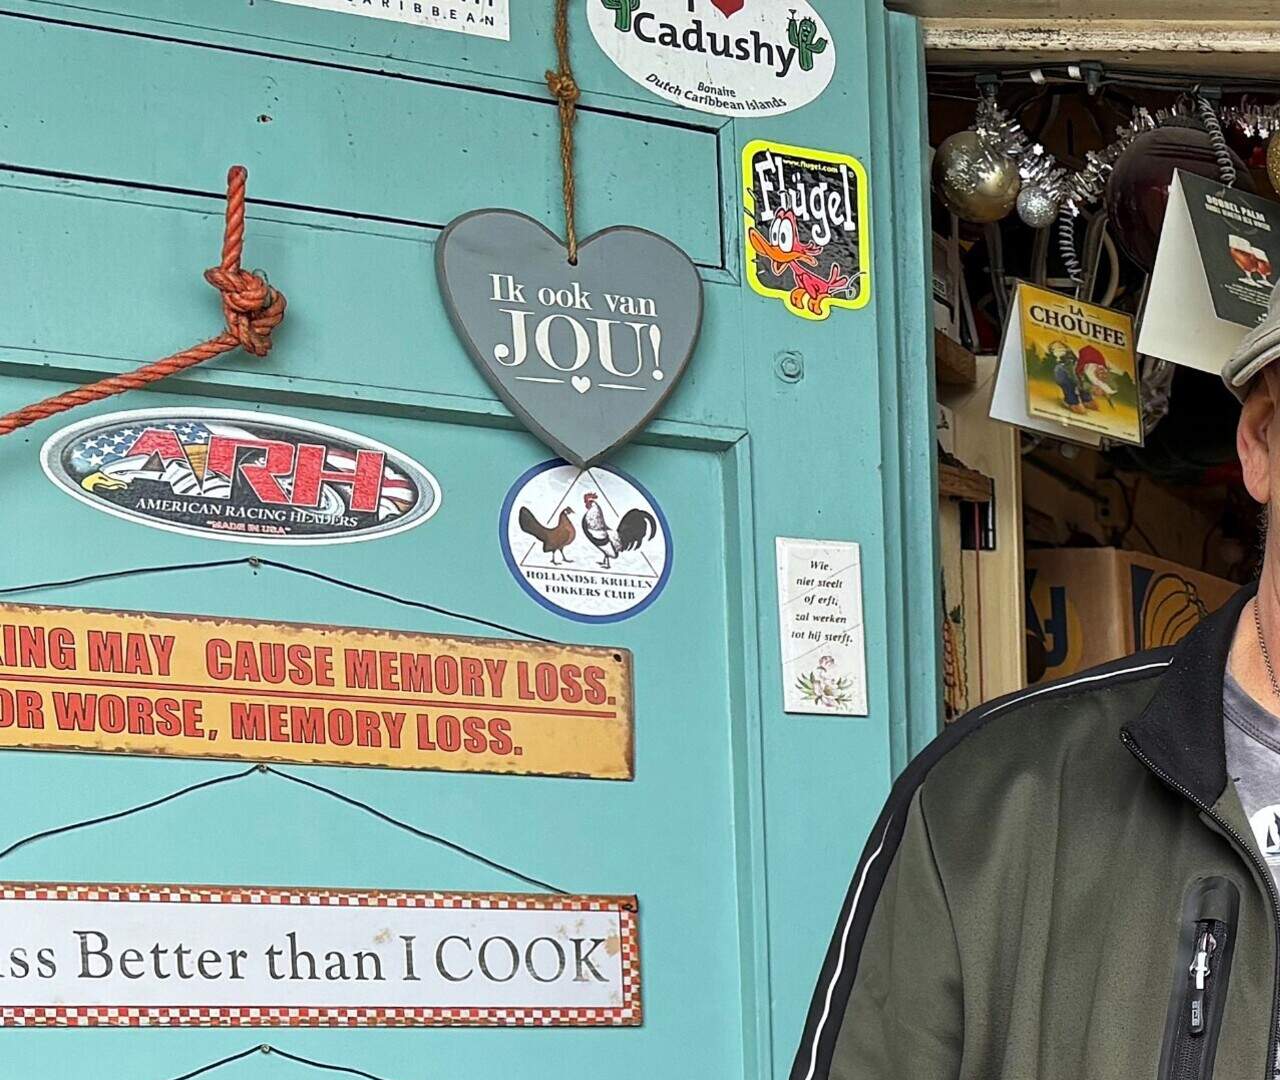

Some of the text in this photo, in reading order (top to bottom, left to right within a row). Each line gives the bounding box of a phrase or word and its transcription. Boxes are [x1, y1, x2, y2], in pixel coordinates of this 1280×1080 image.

[633, 12, 796, 78] Cadushy
[645, 73, 787, 111] Dutch Caribbean Islands
[697, 81, 736, 98] Bonaire
[755, 151, 856, 246] Flügel
[489, 273, 658, 317] Ik ook van
[1069, 305, 1084, 318] LA
[494, 308, 664, 381] JOU!
[1029, 305, 1126, 347] CHOUFFE
[126, 427, 385, 513] ARH
[135, 497, 359, 528] AMERICAN RACING HEADERS
[526, 570, 598, 585] HOLLANDSE
[545, 584, 635, 600] FOKKERS CLUB
[796, 576, 843, 588] niet steelt
[795, 612, 847, 624] zal werken
[804, 594, 816, 605] of
[791, 631, 805, 640] tot
[808, 630, 822, 642] hij
[0, 624, 618, 707] ING MAY CAUSE MEMORY LOSS.
[53, 692, 218, 741] WORSE,
[230, 702, 403, 750] MEMORY
[417, 712, 525, 756] LOSS.
[0, 930, 610, 983] ss Better than I COOK
